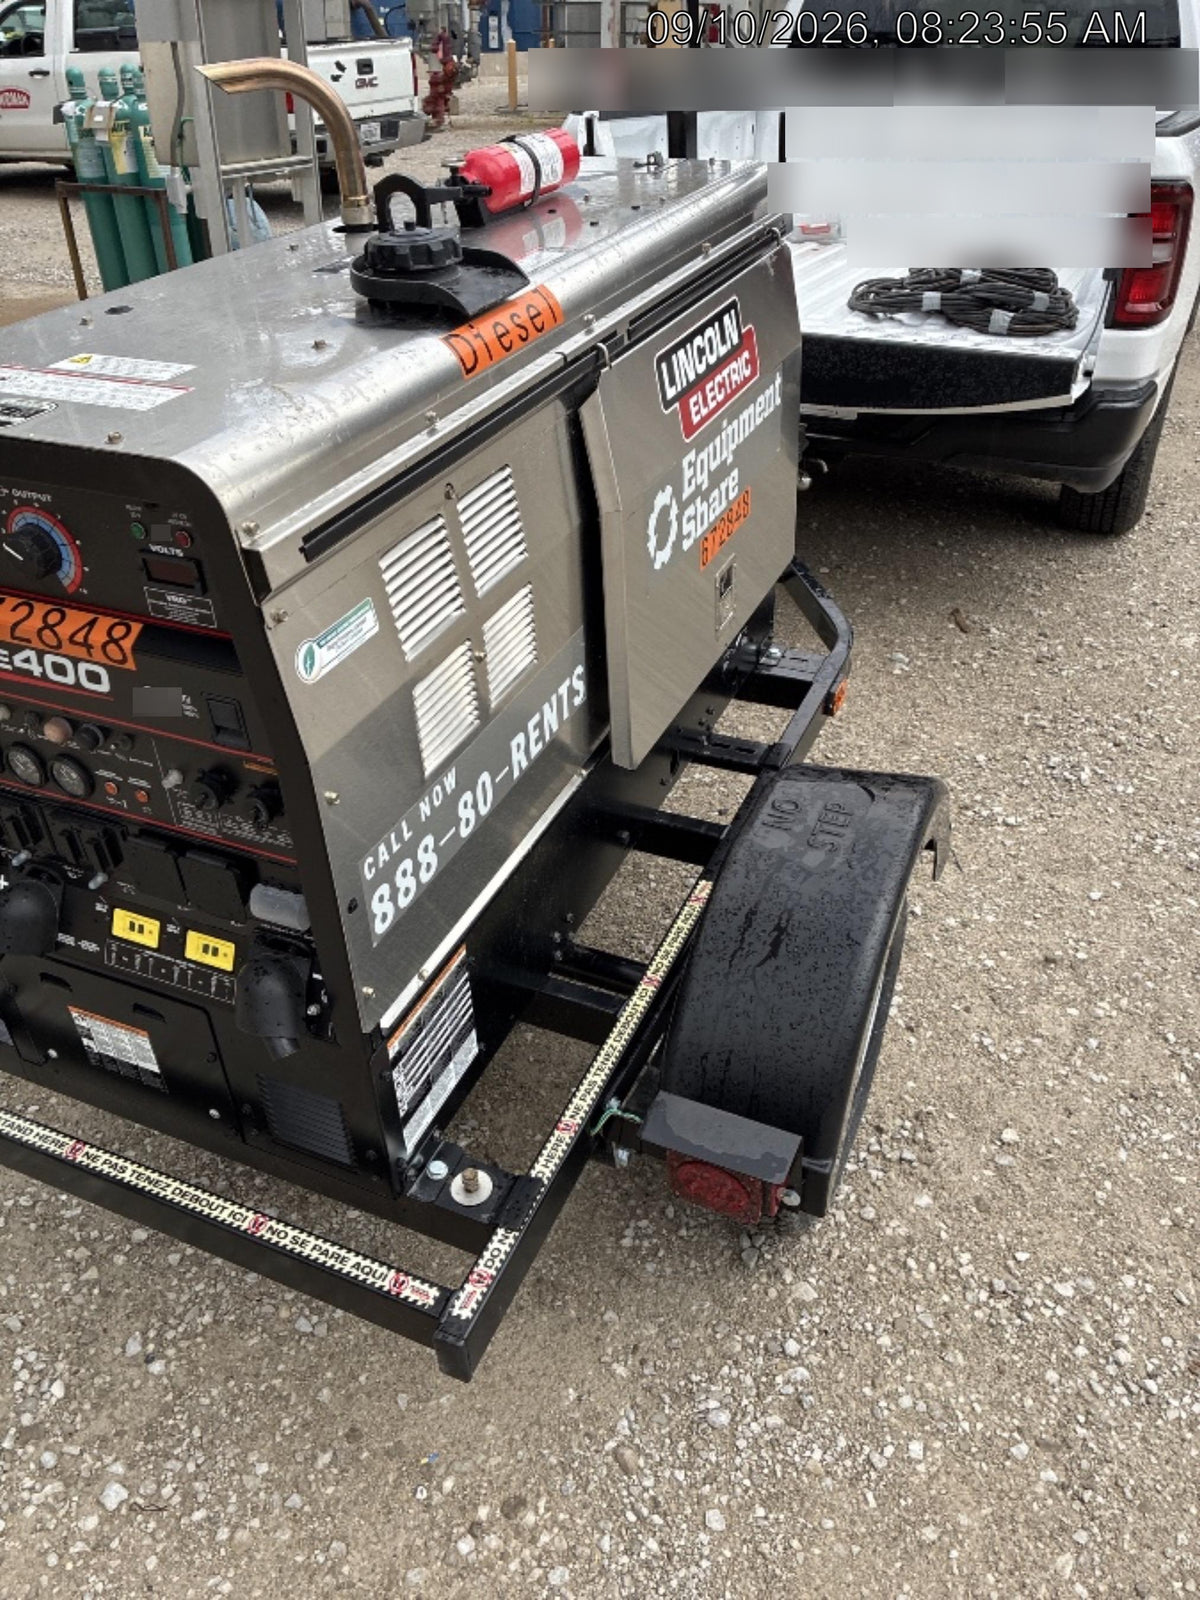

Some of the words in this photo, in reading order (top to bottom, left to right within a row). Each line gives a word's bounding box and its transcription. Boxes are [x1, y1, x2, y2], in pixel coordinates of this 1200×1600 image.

[355, 76, 378, 89] GMC
[443, 287, 560, 378] Diesel
[660, 306, 740, 400] LINCOLN
[688, 350, 752, 425] ELECTRIC
[682, 371, 783, 501] Equipment
[682, 467, 740, 552] Share
[0, 597, 133, 668] 2848
[364, 821, 413, 881] CALL
[419, 765, 458, 822] NOW
[371, 664, 586, 936] 888-80-RENTS
[761, 799, 801, 831] NO
[806, 801, 853, 853] STEP
[0, 1118, 33, 1138] TAND
[82, 1151, 101, 1165] NE
[102, 1157, 129, 1175] PAS
[129, 1168, 171, 1192] TENEZ
[171, 1186, 228, 1216] DEBOUT
[267, 1225, 289, 1242] NO
[289, 1234, 311, 1250] SE
[311, 1243, 349, 1267] PARE
[351, 1260, 388, 1283] AQUI
[484, 1247, 504, 1270] DO
